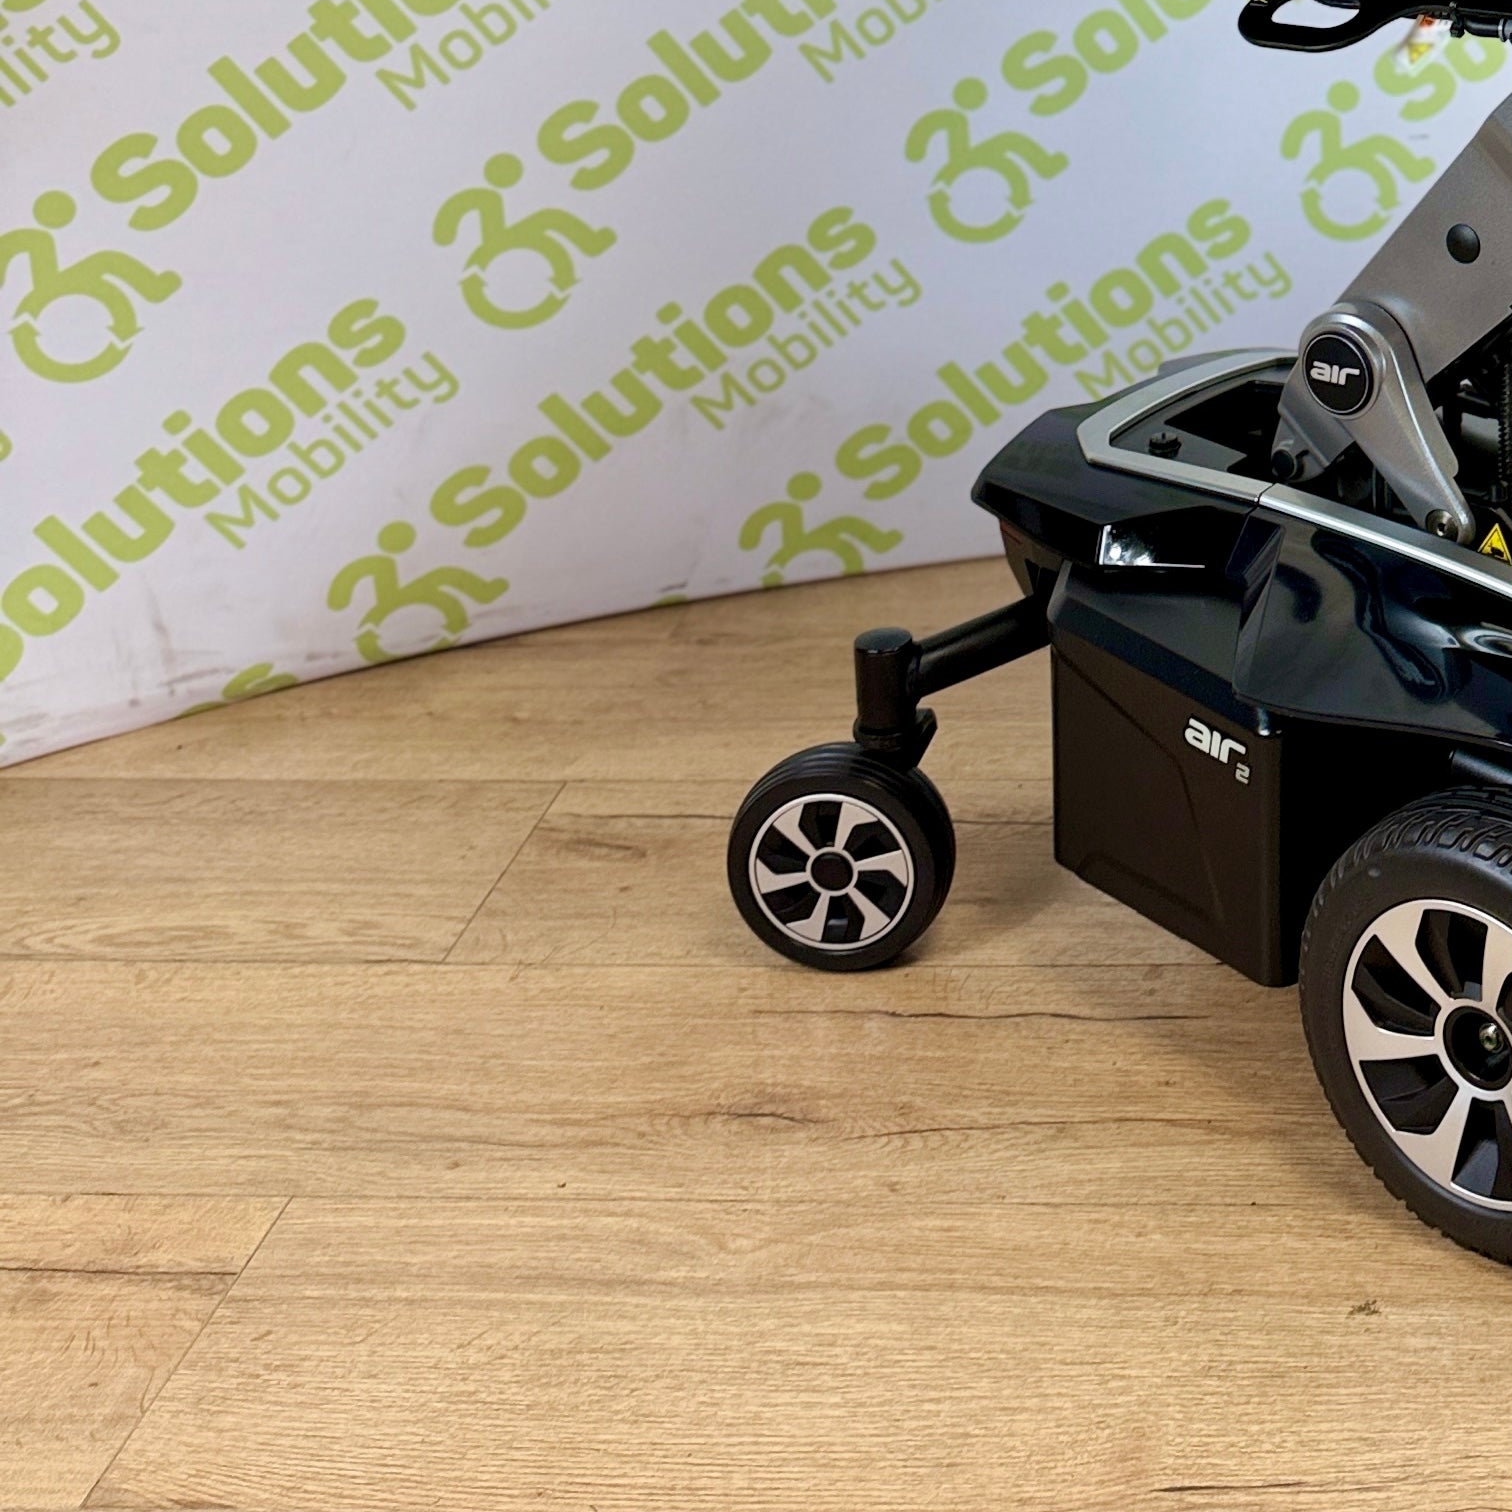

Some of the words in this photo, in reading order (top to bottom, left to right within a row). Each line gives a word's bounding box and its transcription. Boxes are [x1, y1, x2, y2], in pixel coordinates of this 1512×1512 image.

[429, 206, 878, 550] Solutions
[689, 257, 922, 431] Mobility
[835, 197, 1252, 502] Solutions
[1074, 250, 1292, 402] Mobility
[1309, 360, 1361, 386] air
[203, 350, 460, 551] Mobility
[1184, 717, 1247, 764] air
